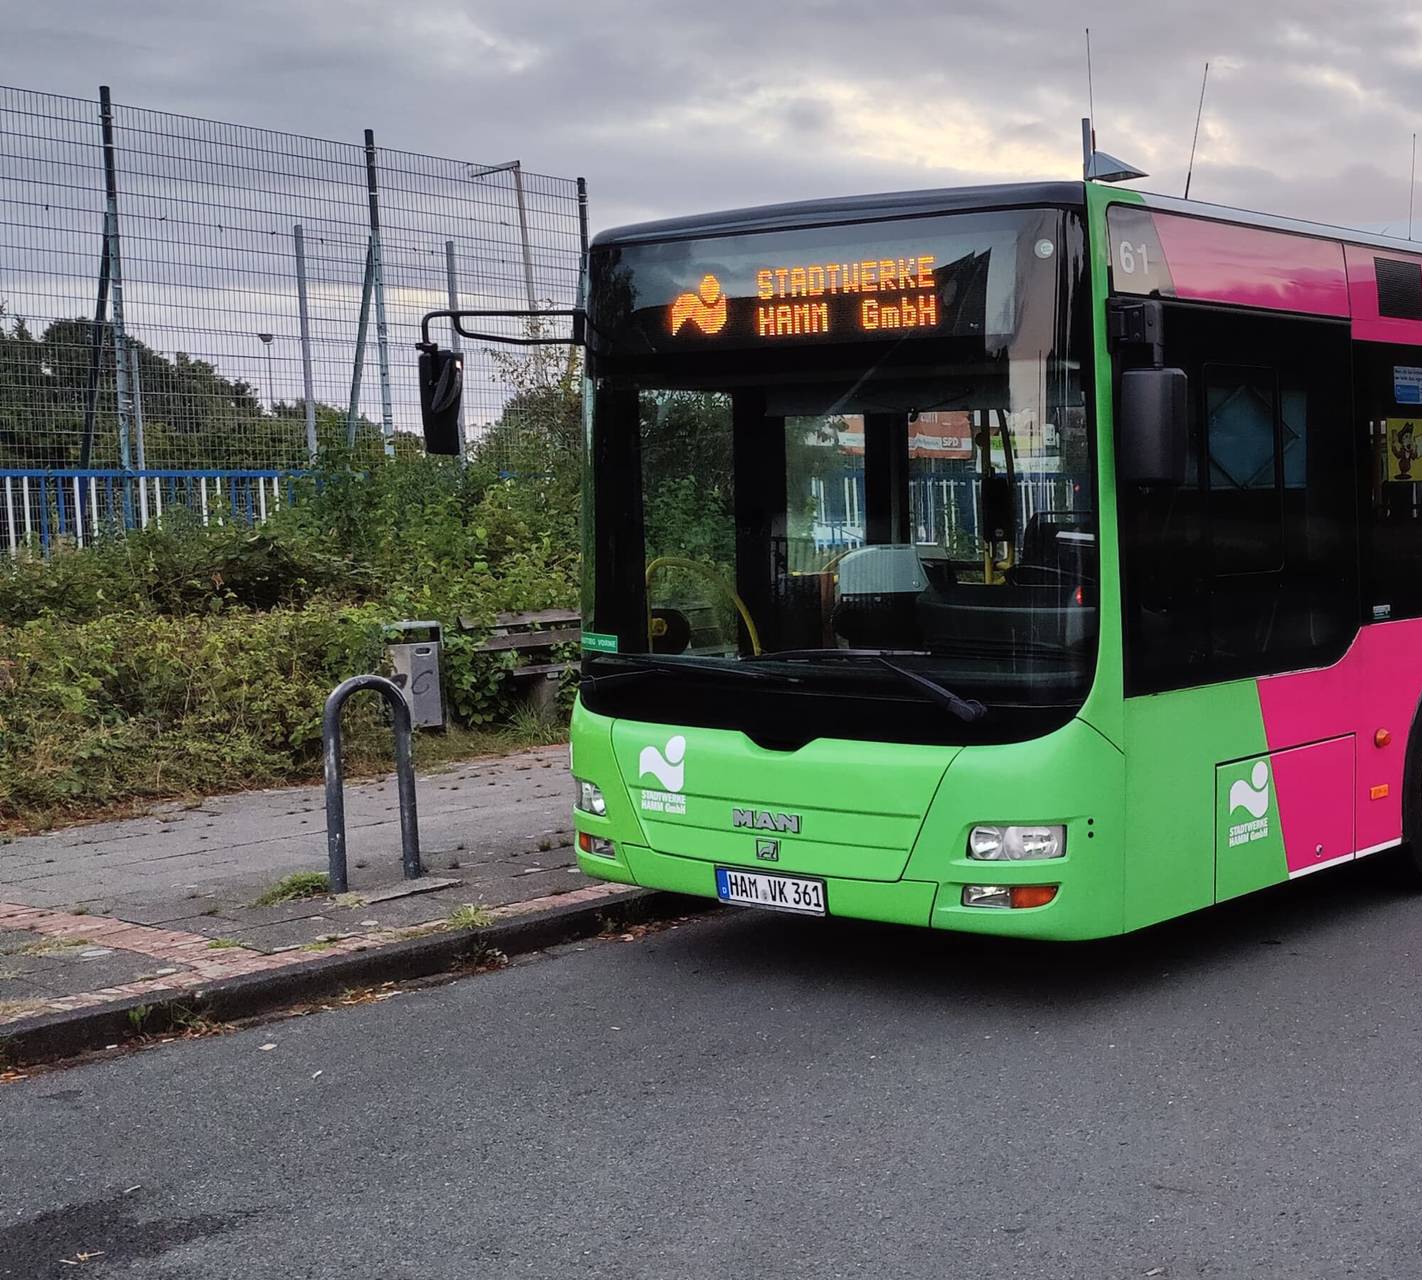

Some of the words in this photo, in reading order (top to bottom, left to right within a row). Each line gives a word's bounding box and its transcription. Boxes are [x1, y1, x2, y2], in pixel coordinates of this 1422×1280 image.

[1120, 241, 1149, 275] 61
[757, 256, 936, 300] STADTWERKE
[758, 302, 829, 336] HAMM
[861, 294, 937, 330] GmbH
[641, 789, 686, 805] STADTWERKE
[641, 799, 664, 812] HAMM
[664, 802, 686, 815] GmbH
[732, 808, 803, 834] MAN
[1229, 817, 1268, 837] STADTWERKE
[1229, 832, 1249, 848] HAMM
[1250, 827, 1268, 841] GmbH
[728, 874, 759, 900] HAM
[767, 879, 789, 904] VK
[791, 882, 822, 908] 361
